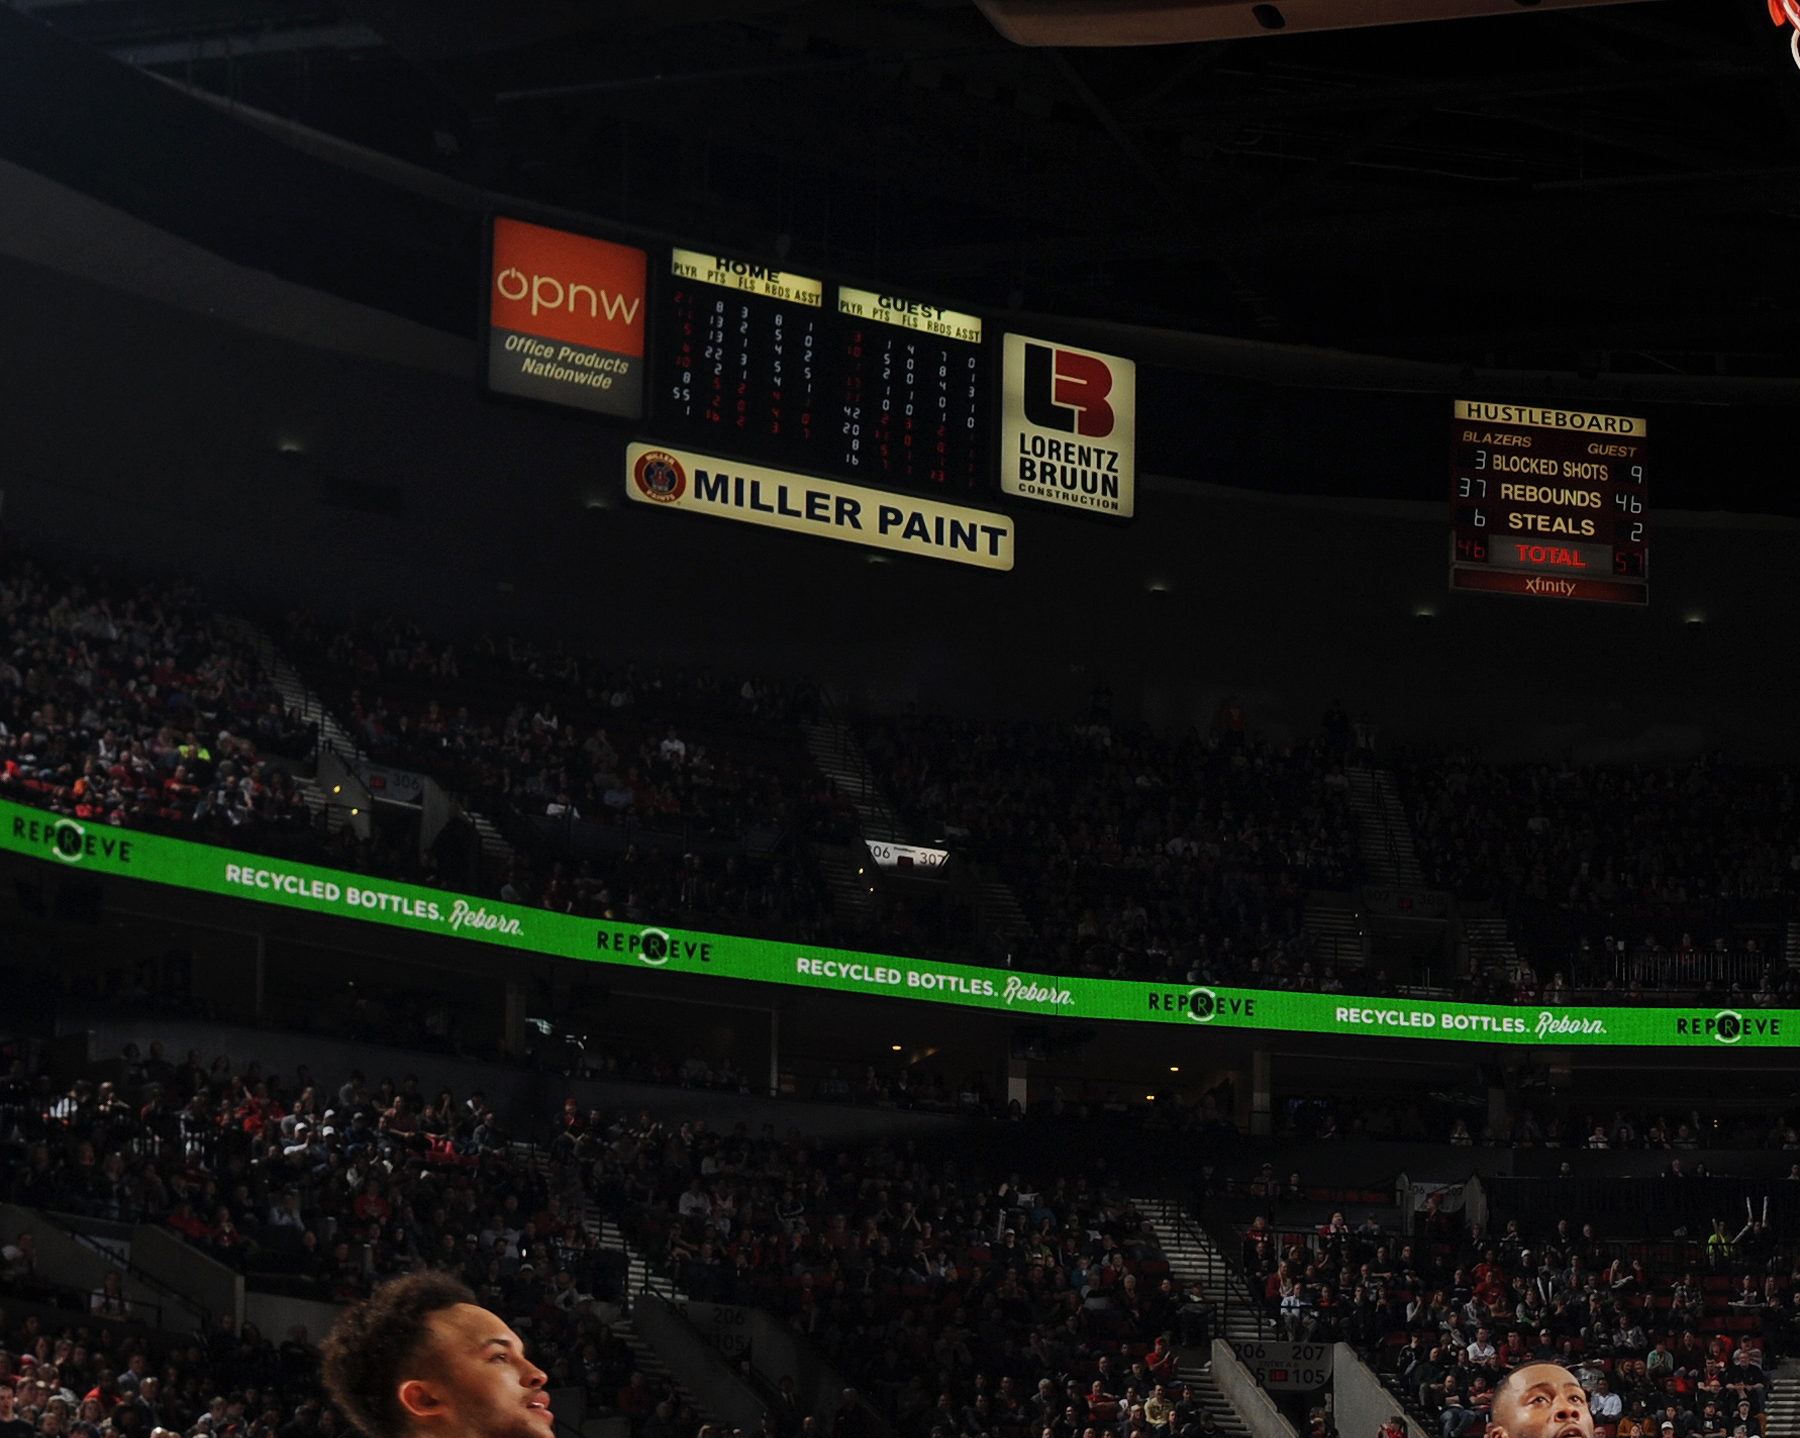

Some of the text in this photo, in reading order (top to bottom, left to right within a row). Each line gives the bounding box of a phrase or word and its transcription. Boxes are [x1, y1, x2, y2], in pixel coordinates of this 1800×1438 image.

[674, 262, 821, 305] PLYR PTS FLS RBDS ASST
[716, 256, 780, 283] HOME
[497, 267, 639, 325] opnw
[878, 294, 947, 320] GUEST
[840, 300, 980, 341] PLYR PTS FLS RBDS ASST
[505, 335, 629, 374] Office Products
[522, 358, 612, 389] Nationwide
[1467, 403, 1634, 434] HUSTLEBOARD
[1020, 432, 1119, 473] LORENTZ
[1463, 431, 1637, 458] BLAZERS GUEST
[1019, 457, 1118, 499] BRUUN
[1493, 454, 1609, 482] BLOCKED SHOTS
[1018, 483, 1119, 511] CONSTRUCTION
[1459, 477, 1642, 514] 37 REBOUNDS 46
[694, 469, 1008, 556] MILLER PAINT
[1508, 512, 1595, 536] STEALS
[1516, 544, 1587, 568] TOTAL
[1525, 577, 1576, 596] xfinity
[226, 864, 524, 936] RECYCLED BOTTLES. Reborn.
[796, 957, 1075, 1005] RECYCLED BOTTLES. Reborn.
[1335, 1007, 1607, 1039] RECYCLED BOTTLES. Reborn.
[1292, 1346, 1325, 1360] 207
[1293, 1369, 1325, 1384] 105
